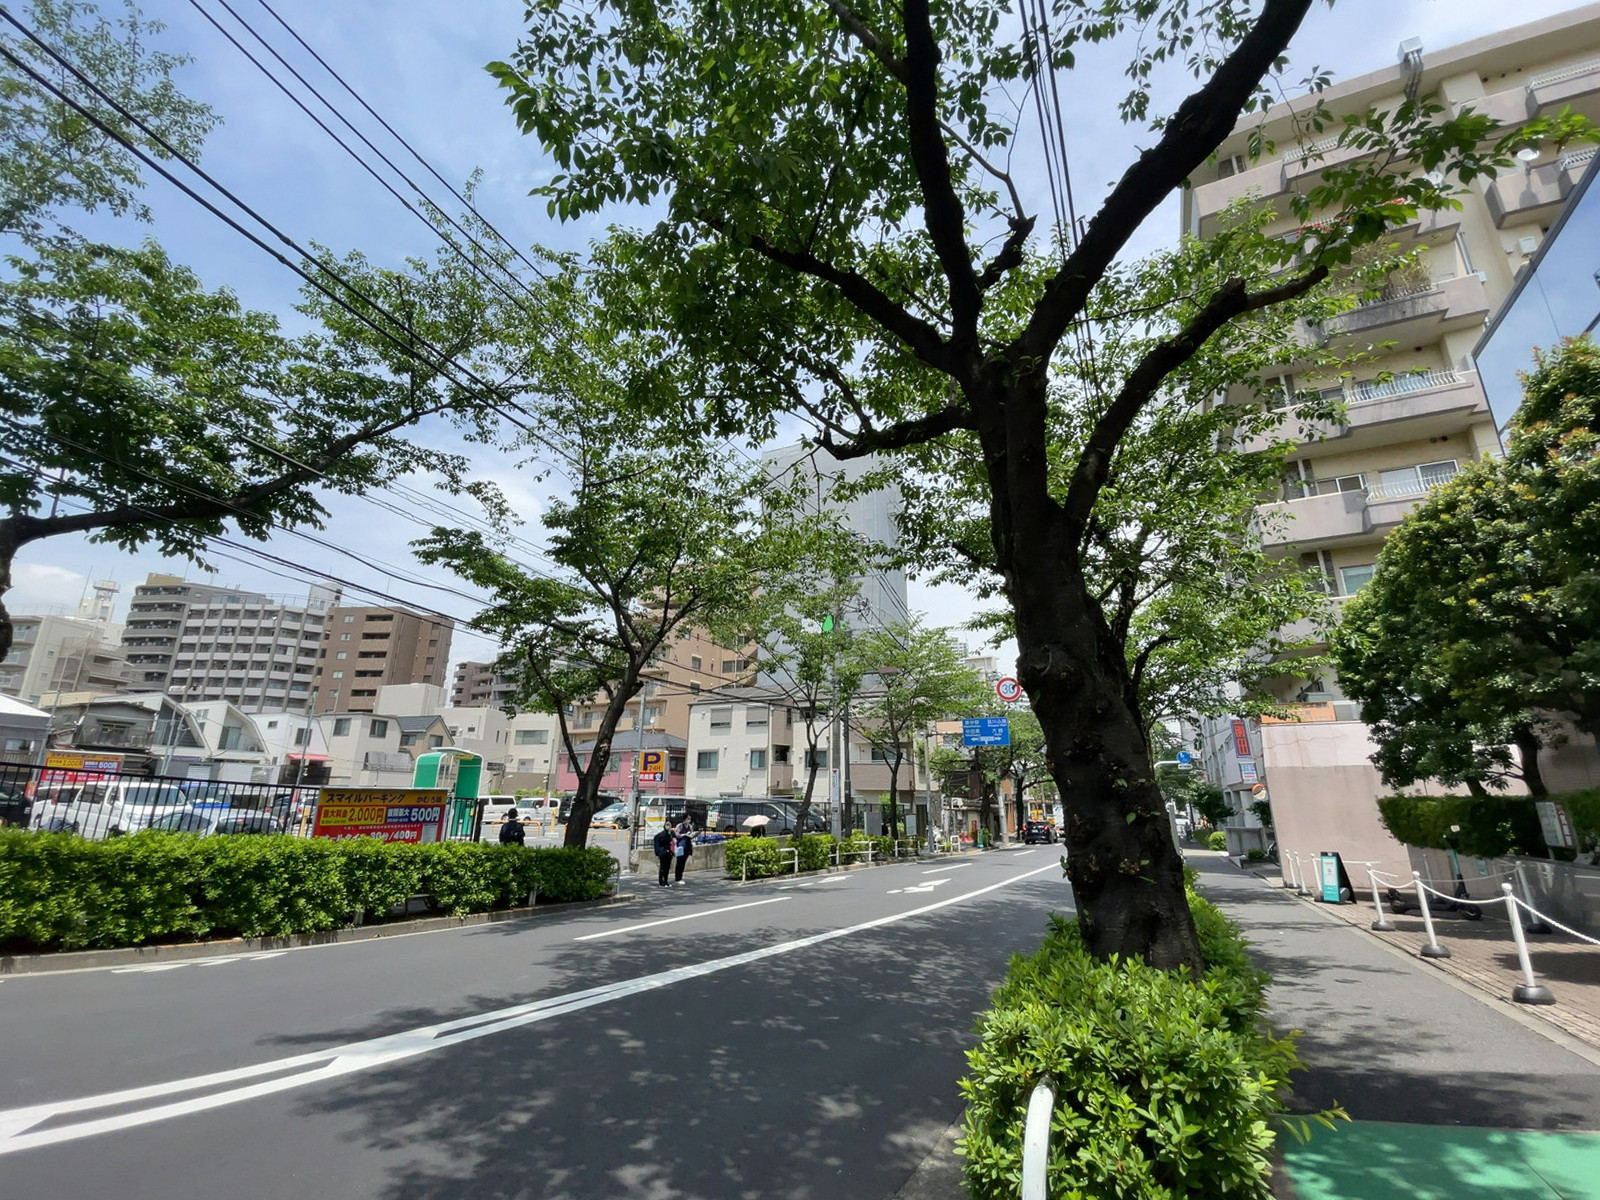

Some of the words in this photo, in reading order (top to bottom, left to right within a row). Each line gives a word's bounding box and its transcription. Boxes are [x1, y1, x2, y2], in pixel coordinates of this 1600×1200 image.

[1002, 683, 1015, 695] 30
[642, 752, 662, 771] P
[326, 793, 406, 804] スマイルパーキング
[348, 807, 385, 823] 2,000円
[411, 807, 441, 822] 500円
